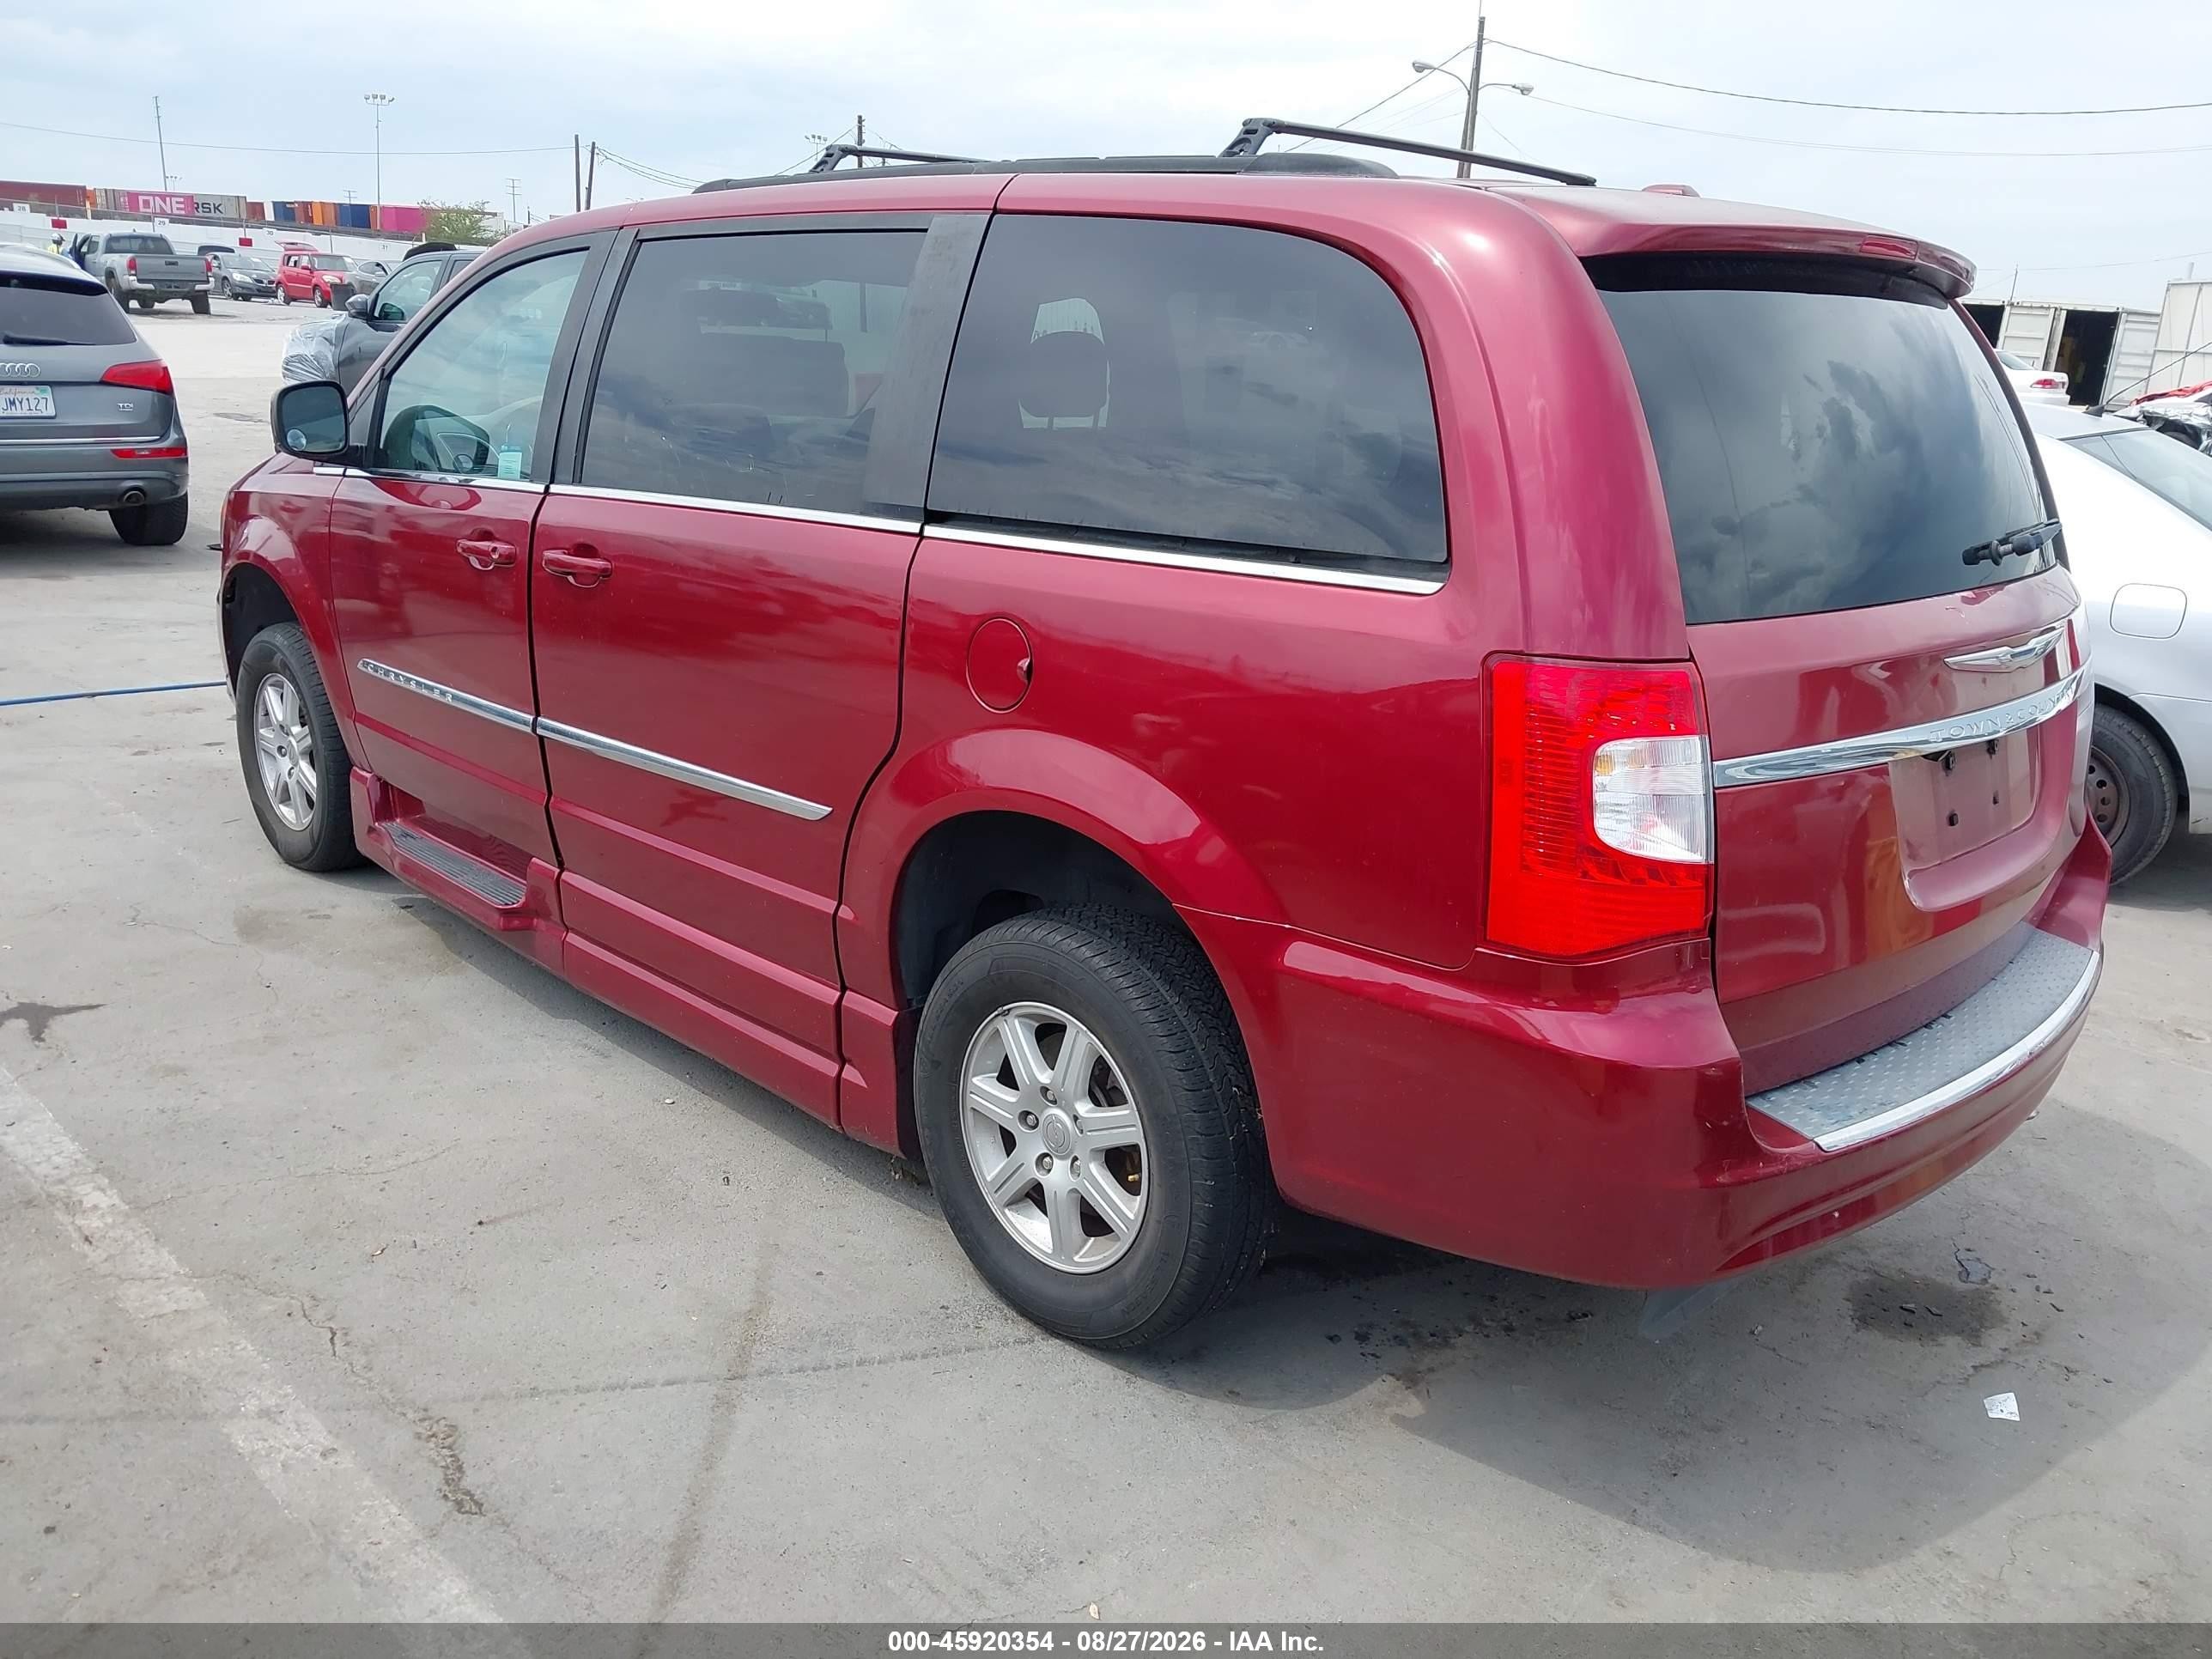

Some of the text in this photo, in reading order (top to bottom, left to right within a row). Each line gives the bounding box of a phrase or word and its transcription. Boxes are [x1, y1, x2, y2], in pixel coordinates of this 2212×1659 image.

[138, 195, 185, 214] ONE
[367, 664, 453, 702] CHRYSLER
[1929, 716, 2002, 742] TOWN
